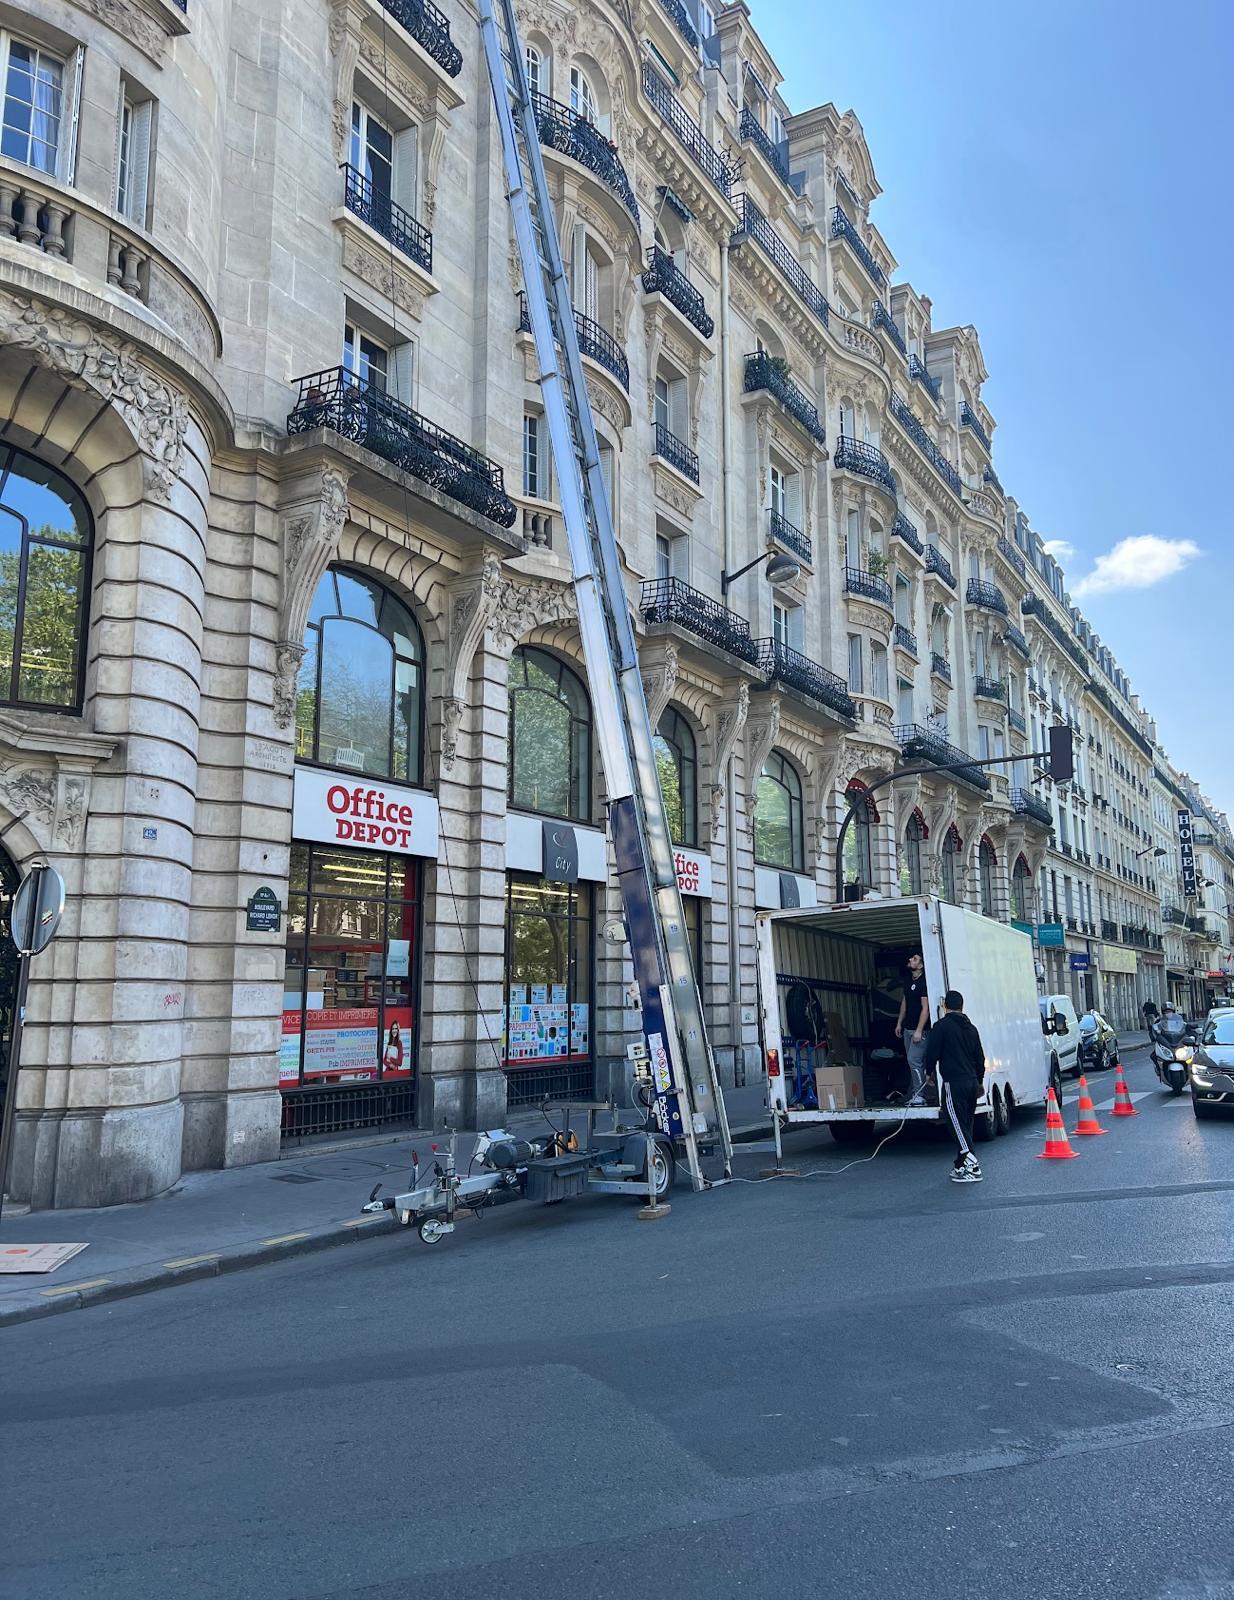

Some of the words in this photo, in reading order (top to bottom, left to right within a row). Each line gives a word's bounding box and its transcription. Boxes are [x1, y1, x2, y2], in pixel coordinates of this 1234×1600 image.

[327, 785, 413, 826] Office
[335, 818, 411, 848] DEPOT
[1178, 815, 1195, 882] HOTEL
[555, 856, 571, 874] City
[673, 852, 699, 877] fice
[678, 875, 699, 892] POT
[307, 1009, 328, 1021] COPIE
[329, 1009, 338, 1020] ET
[339, 1008, 377, 1020] IMPRIMERIE
[658, 1096, 671, 1136] Böcker
